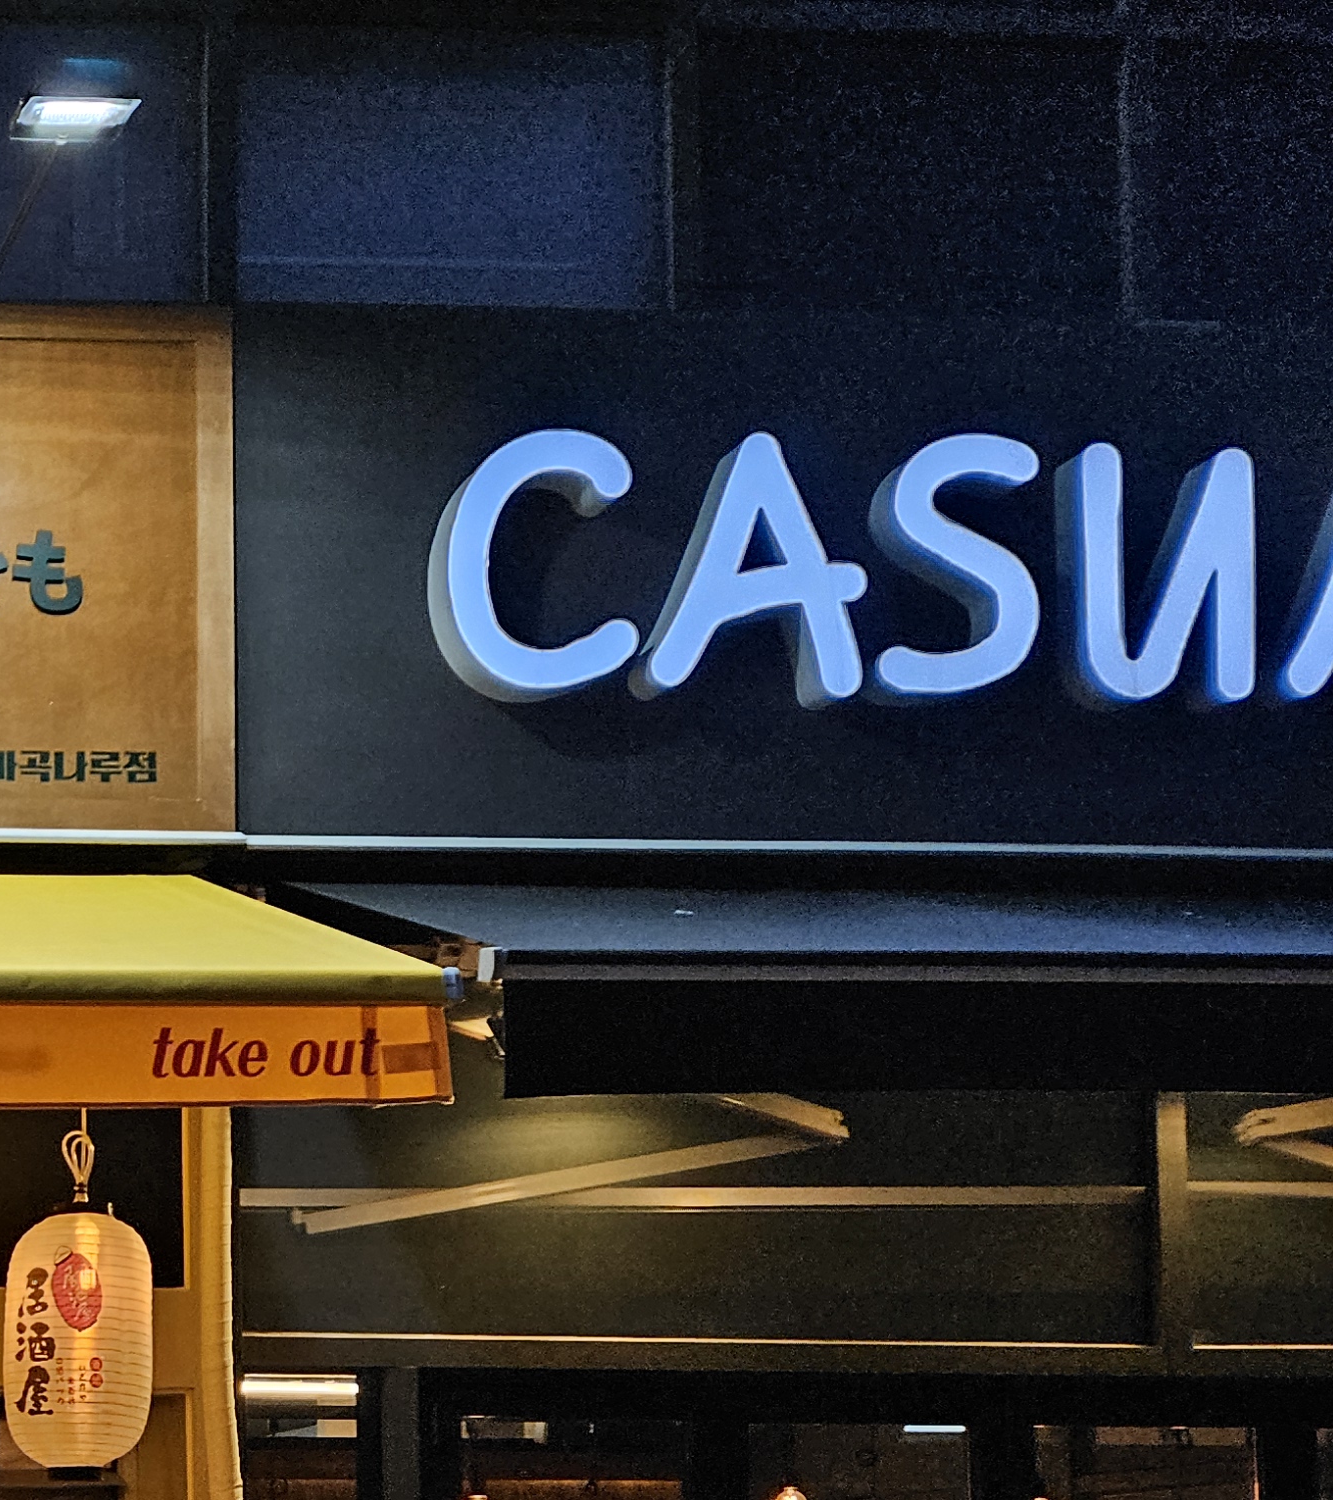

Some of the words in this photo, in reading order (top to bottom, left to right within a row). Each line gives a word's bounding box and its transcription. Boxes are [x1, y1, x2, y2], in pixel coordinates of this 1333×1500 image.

[427, 428, 1333, 708] CASU
[151, 1027, 269, 1079] take
[289, 1027, 381, 1077] out
